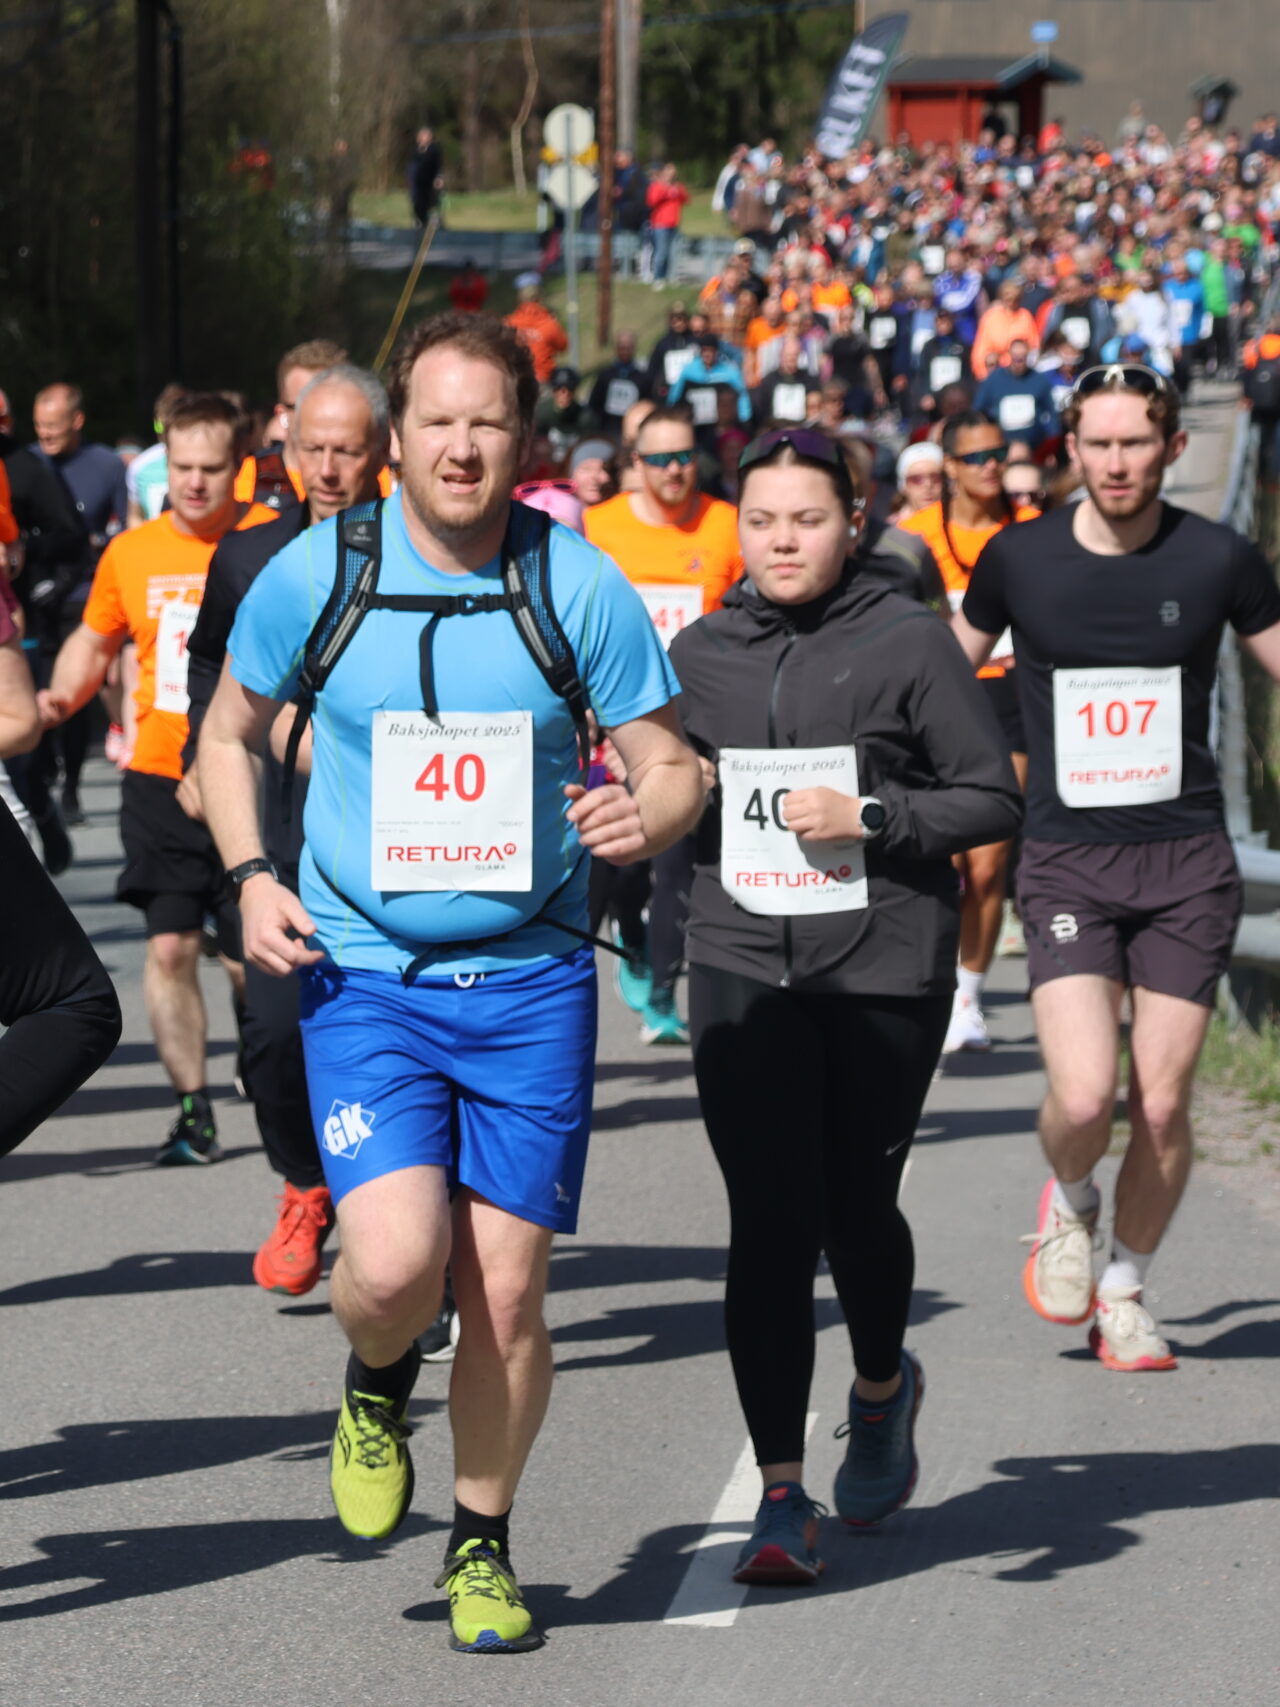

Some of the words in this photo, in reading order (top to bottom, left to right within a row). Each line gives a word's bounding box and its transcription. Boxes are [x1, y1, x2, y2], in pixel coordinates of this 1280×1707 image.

[1077, 700, 1158, 738] 107
[387, 723, 479, 741] Baksjøløpet
[484, 724, 521, 738] 2025
[415, 753, 486, 802] 40
[1069, 767, 1160, 785] RETURA
[387, 845, 504, 862] RETURA
[736, 868, 841, 888] RETURA
[323, 1102, 373, 1156] GK
